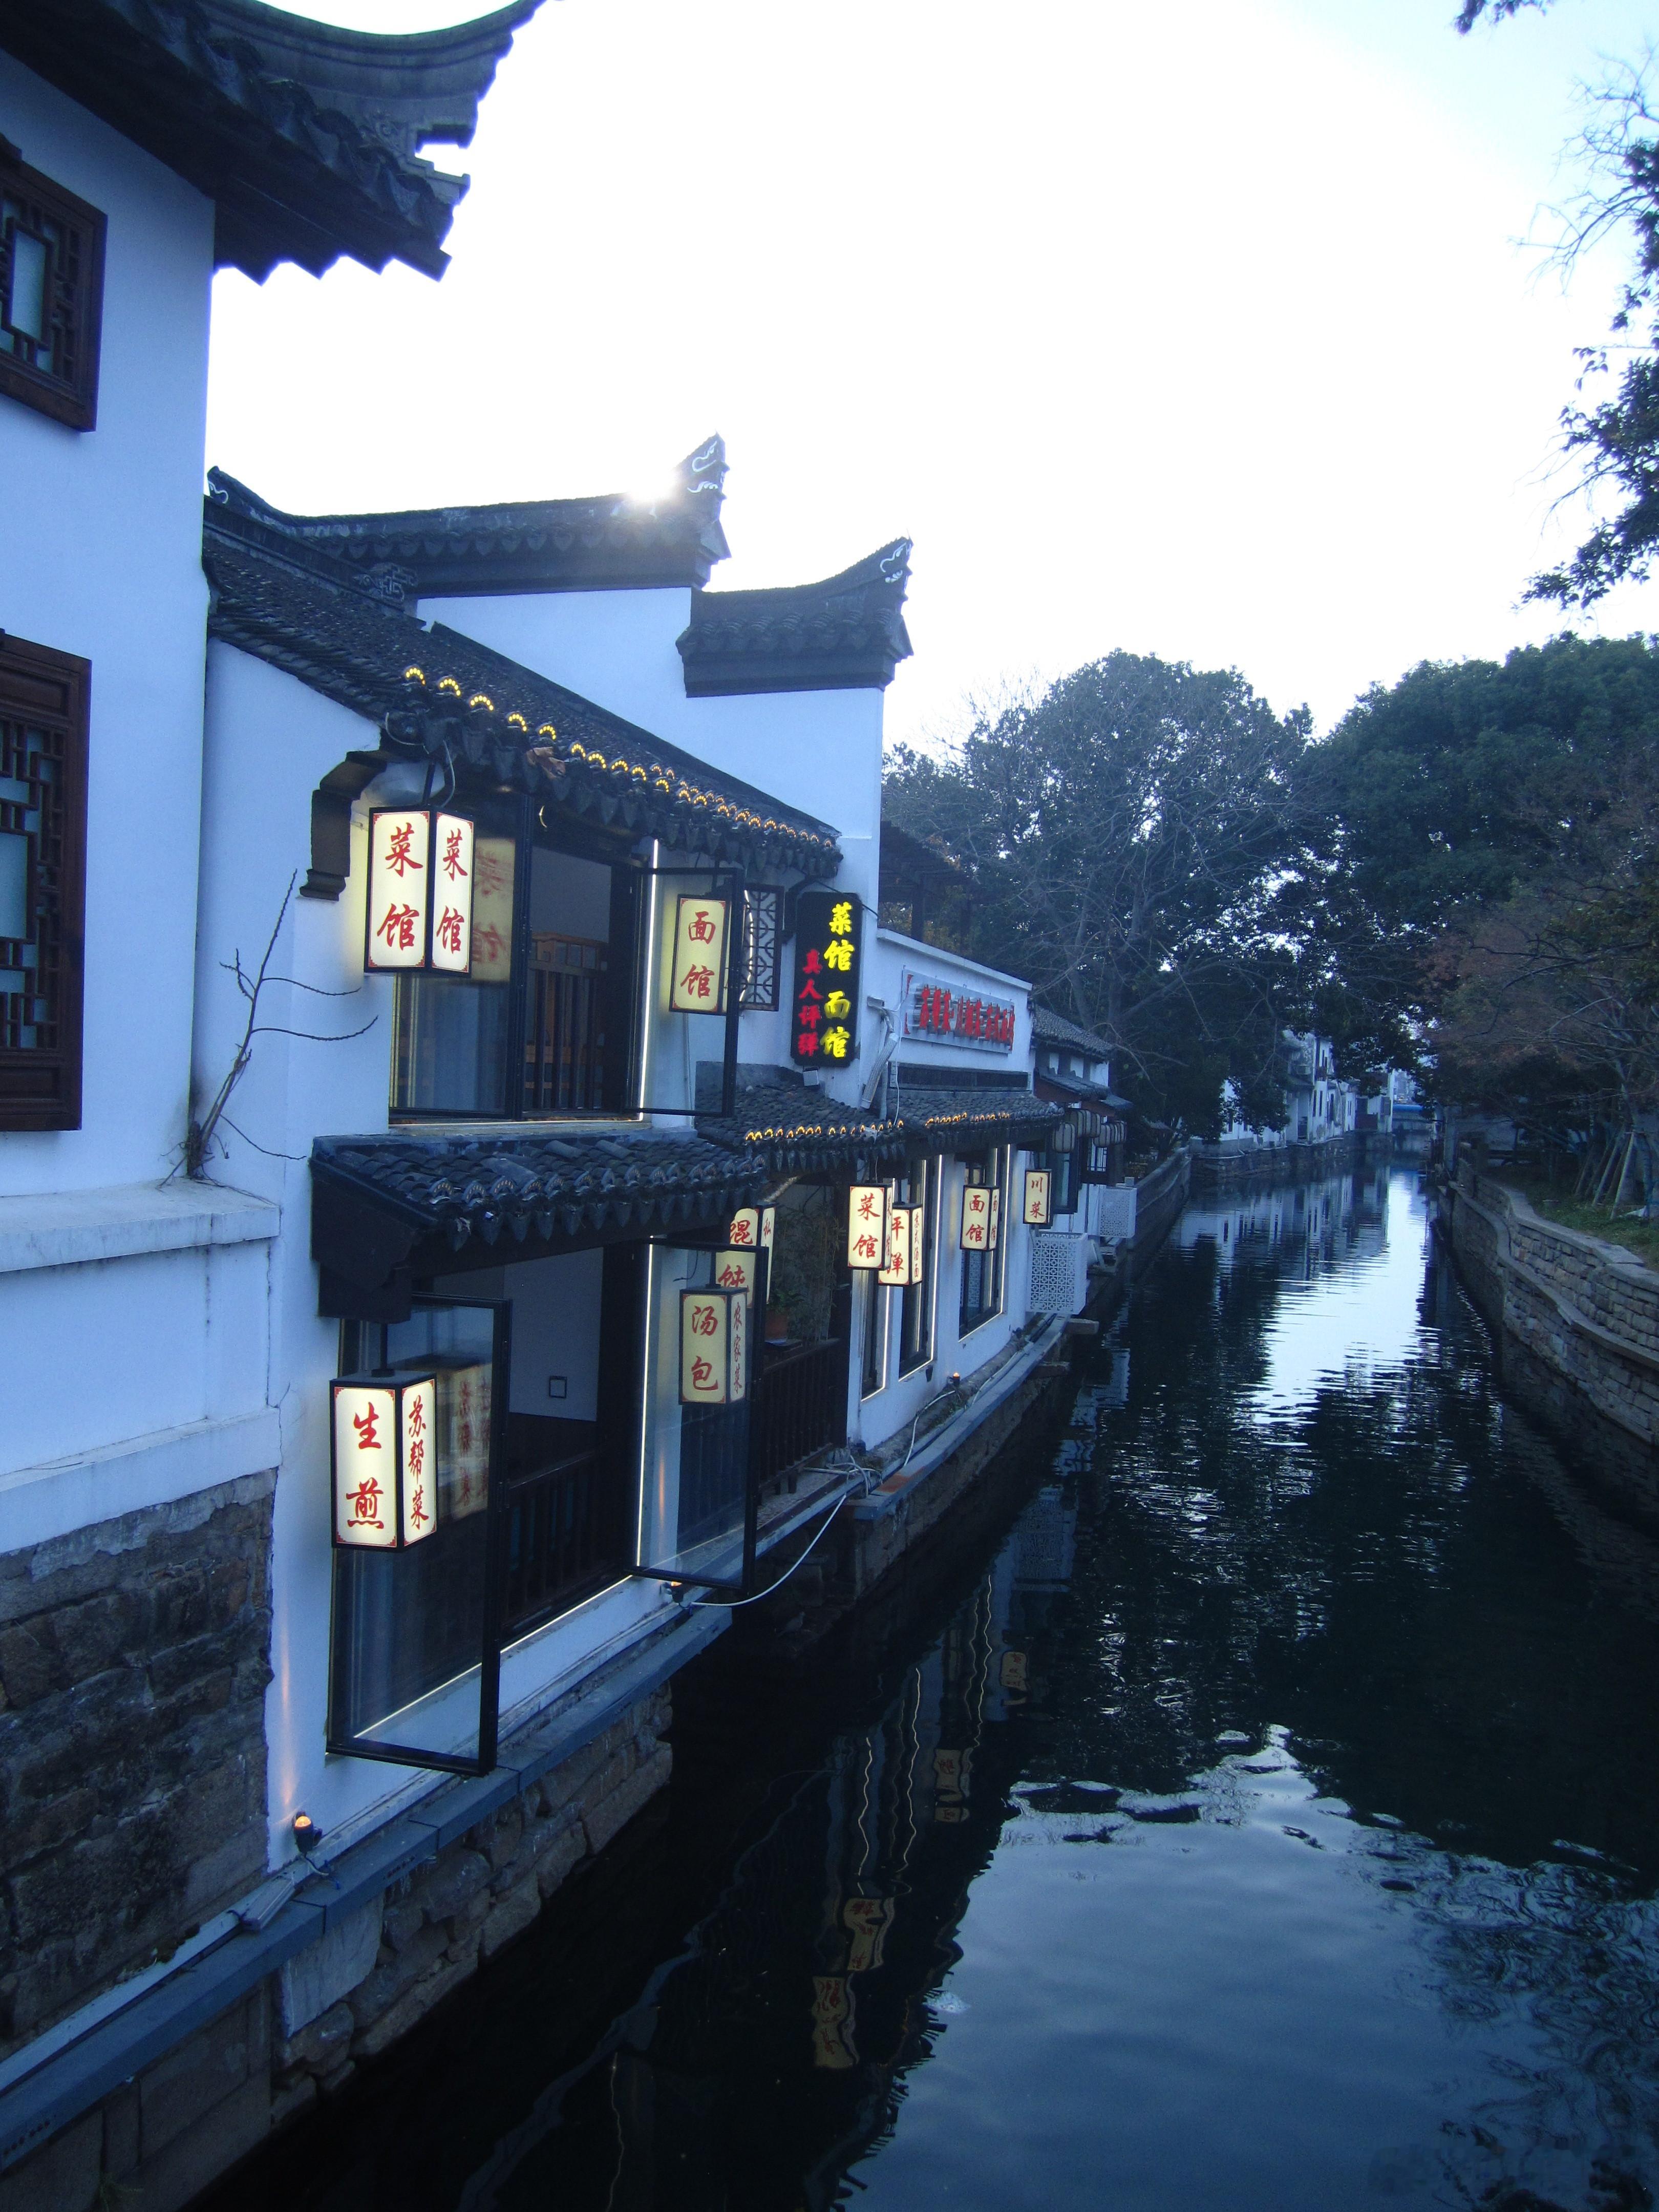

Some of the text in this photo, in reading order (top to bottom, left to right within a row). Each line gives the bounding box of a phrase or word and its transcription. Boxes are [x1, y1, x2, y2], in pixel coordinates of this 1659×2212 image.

[377, 822, 423, 951] 菜馆
[436, 828, 468, 954] 菜馆
[680, 911, 716, 999] 面馆
[820, 901, 855, 1058] 菜馆 面馆
[853, 1194, 880, 1259] 菜馆
[966, 1195, 985, 1242] 面馆
[1030, 1177, 1044, 1219] 川菜
[691, 1305, 718, 1391] 汤包
[733, 1302, 742, 1394] 农家菜
[346, 1401, 384, 1529] 生煎
[408, 1395, 429, 1529] 苏帮菜
